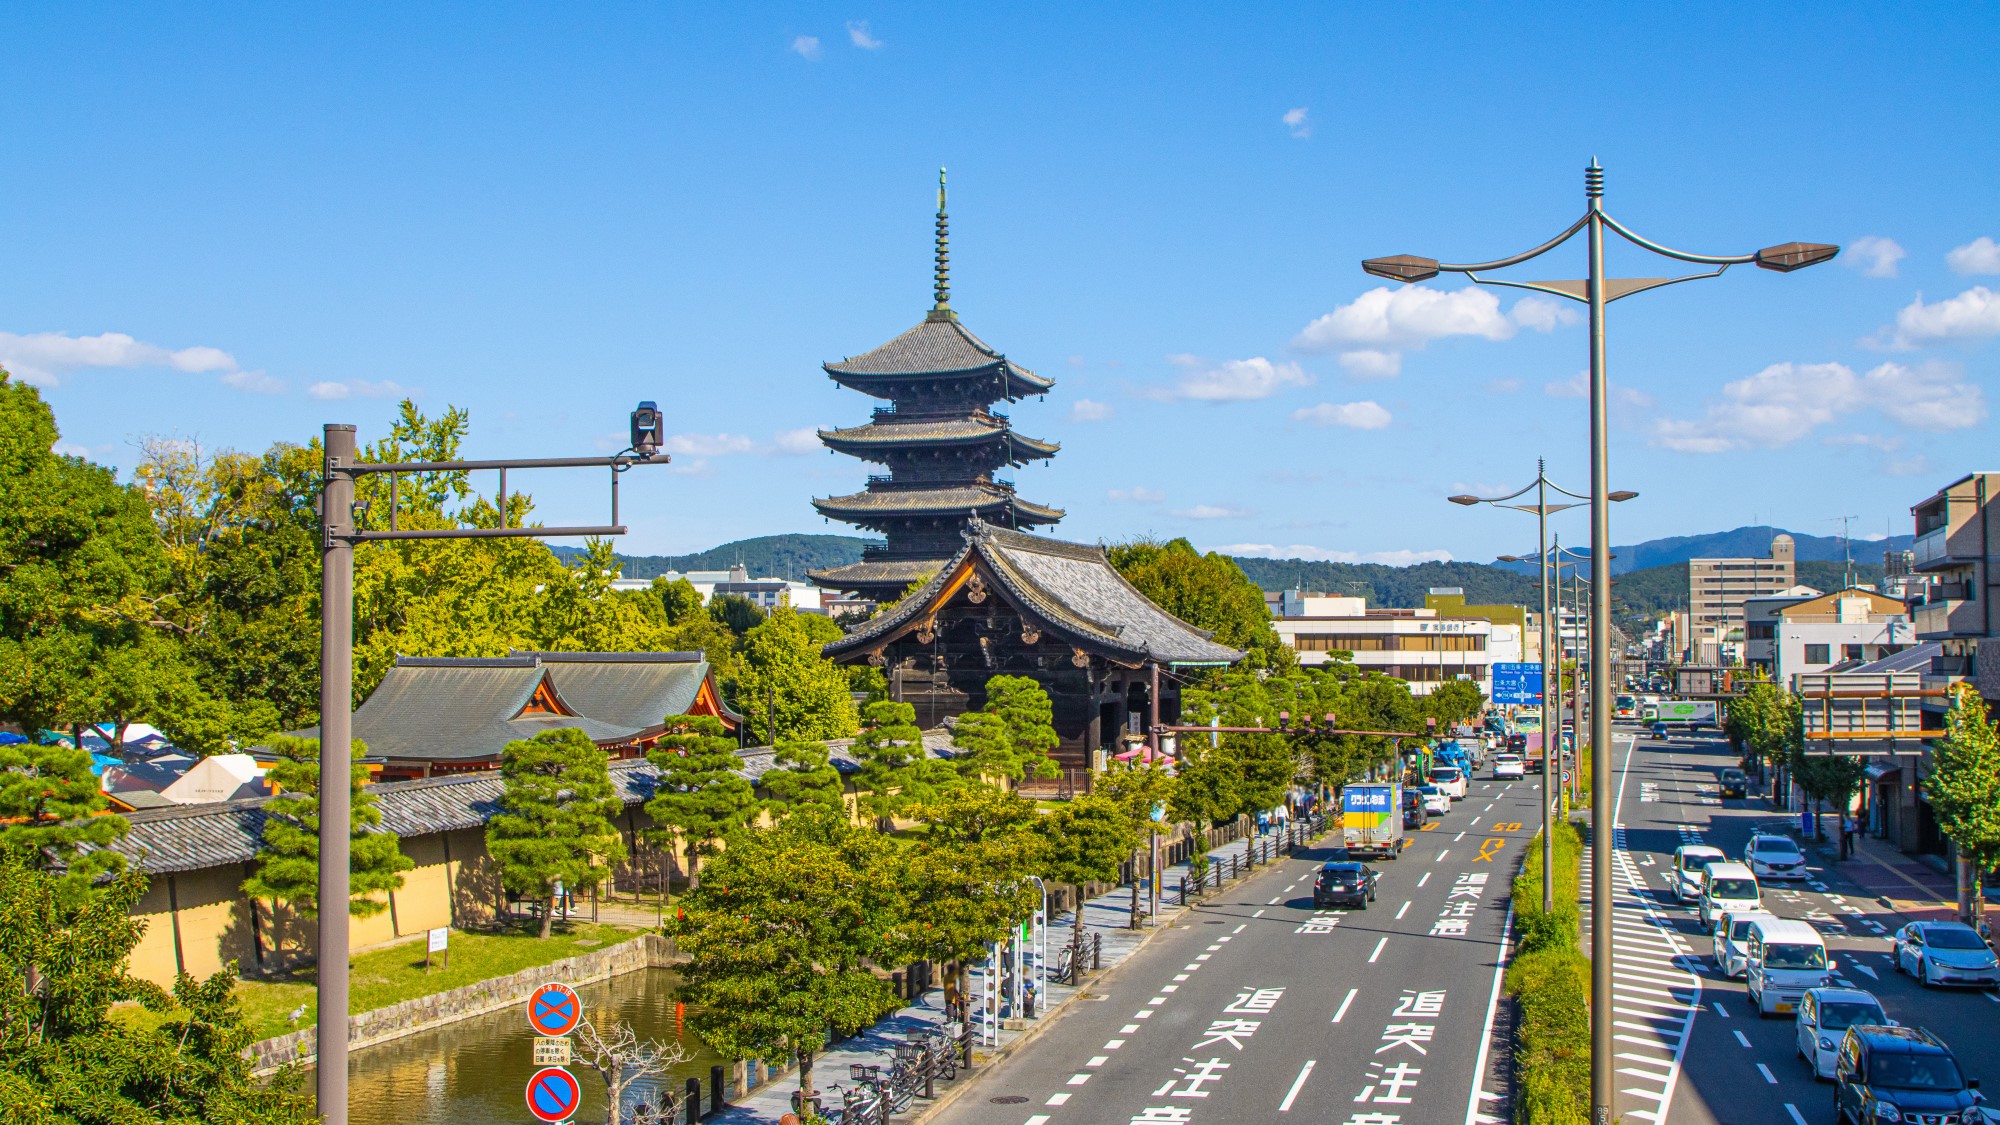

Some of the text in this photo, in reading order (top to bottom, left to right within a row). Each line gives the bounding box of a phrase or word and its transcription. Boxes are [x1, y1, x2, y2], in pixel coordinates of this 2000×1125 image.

[1490, 822, 1523, 832] 50
[1429, 872, 1490, 936] 追突注意
[541, 984, 572, 997] 7-9 17-19
